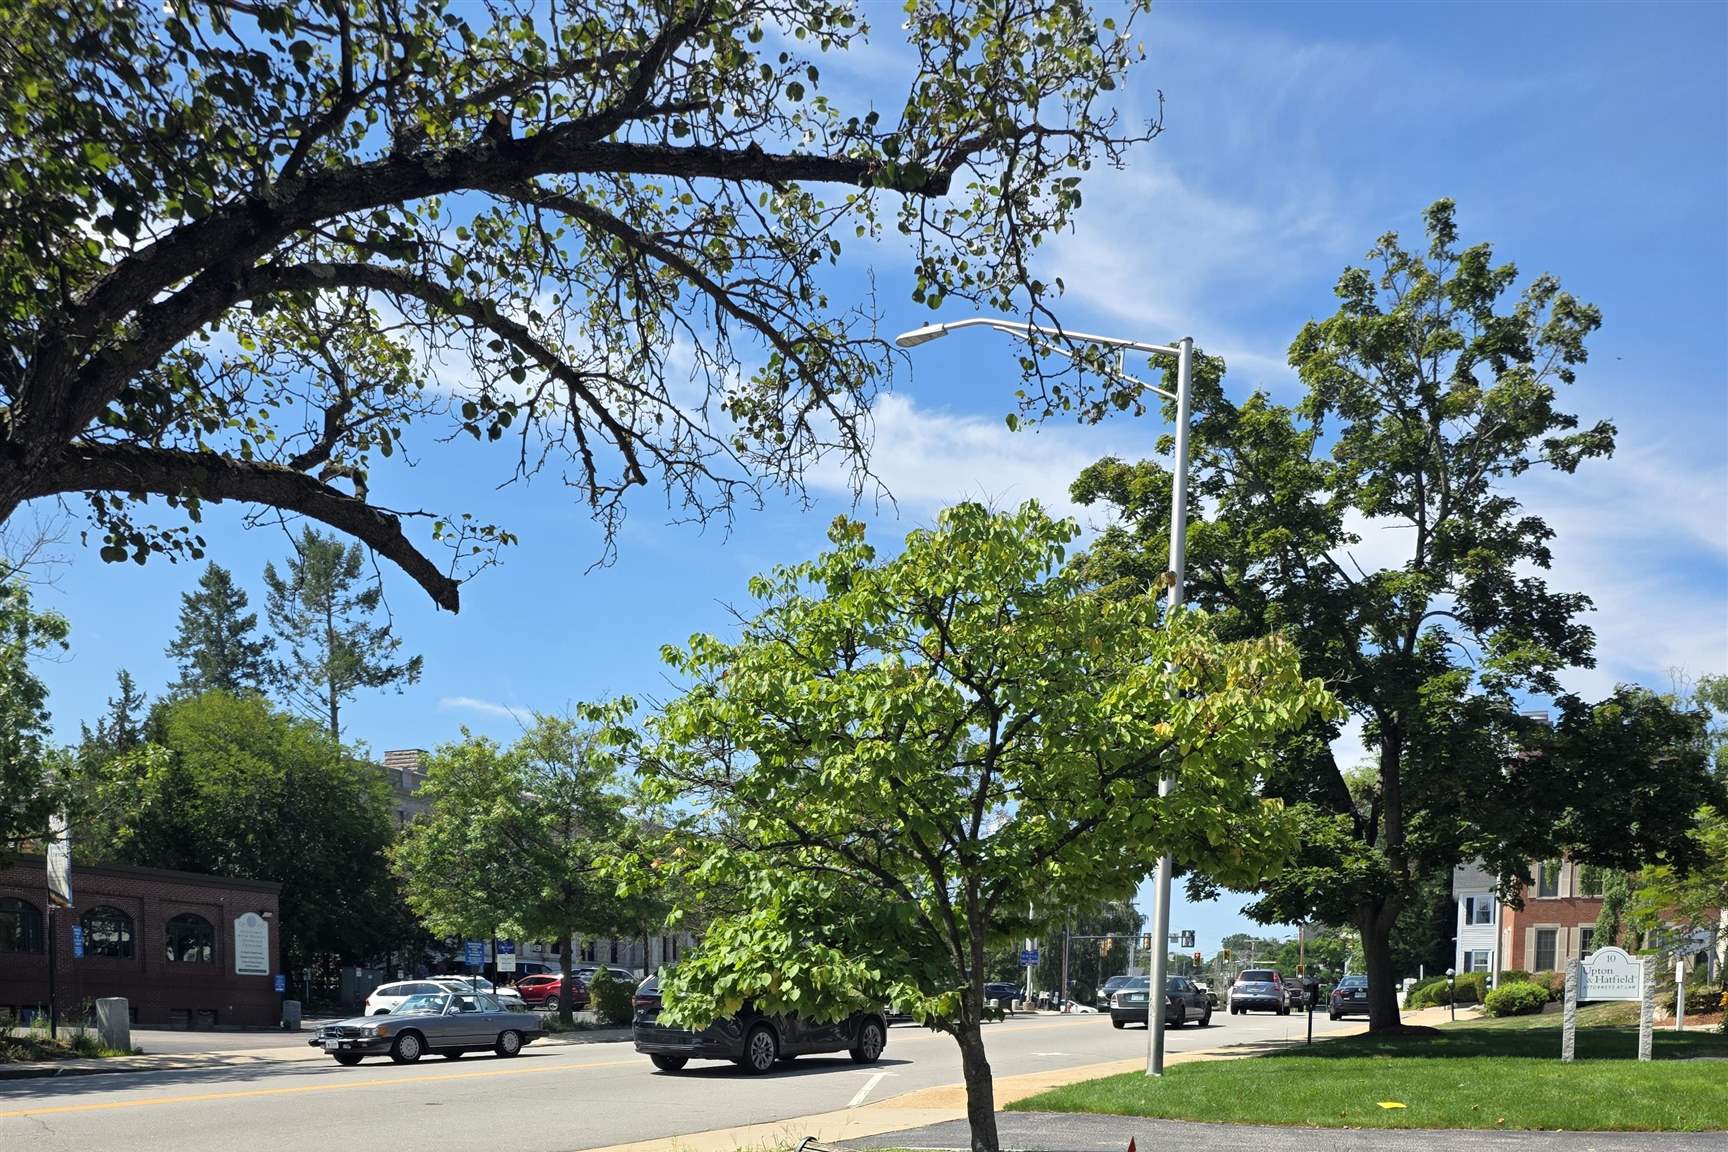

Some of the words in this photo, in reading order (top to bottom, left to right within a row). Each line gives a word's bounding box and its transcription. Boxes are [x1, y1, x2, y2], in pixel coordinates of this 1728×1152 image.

[1607, 955, 1616, 963] 10
[1583, 967, 1613, 976] Upton
[1595, 975, 1634, 984] Hatfield
